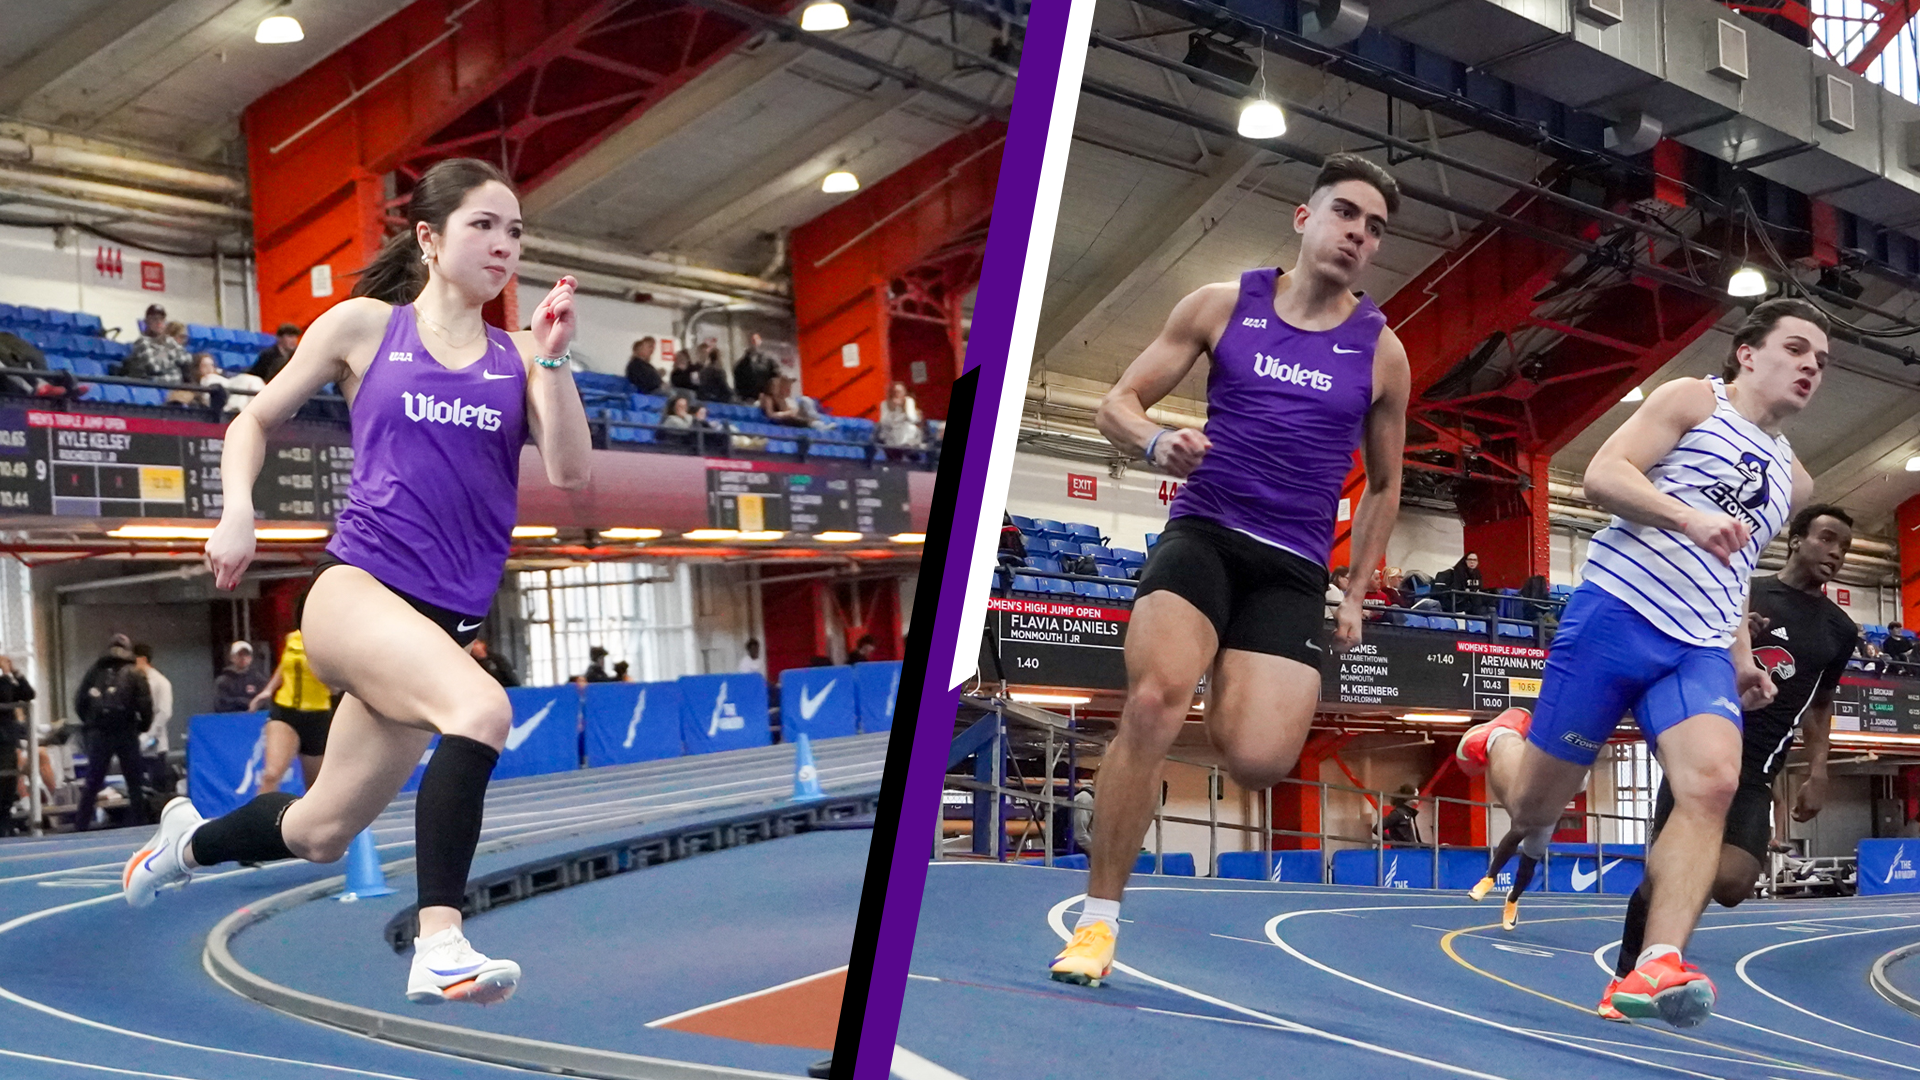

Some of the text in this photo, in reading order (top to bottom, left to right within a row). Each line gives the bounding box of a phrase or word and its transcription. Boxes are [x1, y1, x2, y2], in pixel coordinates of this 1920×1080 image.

[96, 246, 123, 278] 444
[1242, 317, 1267, 329] UAA
[389, 352, 413, 362] UAA
[1253, 352, 1333, 392] Violets
[401, 391, 502, 432] Violets
[55, 413, 82, 428] TRIPLE
[58, 430, 131, 450] KYLE KELSEY
[35, 459, 47, 481] 9
[1073, 478, 1092, 490] EXIT
[1158, 480, 1187, 505] 44
[987, 599, 1101, 618] OMEN'S HIGH JUMP OPEN
[1011, 614, 1119, 635] FLAVIA DANIELS
[1010, 630, 1063, 642] MONMOUTH
[1069, 635, 1080, 643] JR
[1457, 642, 1545, 657] WOMEN'S TRIPLE JUMP OPEN
[1017, 657, 1039, 669] 1.40
[1340, 654, 1388, 663] ELIZABETHTOWN
[1480, 655, 1529, 669] AREYANNA
[1340, 663, 1388, 676] A. GORMAN
[1480, 667, 1494, 675] NYU
[1340, 674, 1374, 682] MONMOUTH
[1462, 673, 1469, 687] 7
[1482, 680, 1501, 689] 10.43
[1340, 684, 1399, 696] M. KREINBERG
[1518, 682, 1536, 692] 10.65
[1482, 698, 1502, 707] 10.00
[1900, 860, 1912, 869] THE
[1496, 872, 1512, 885] THE
